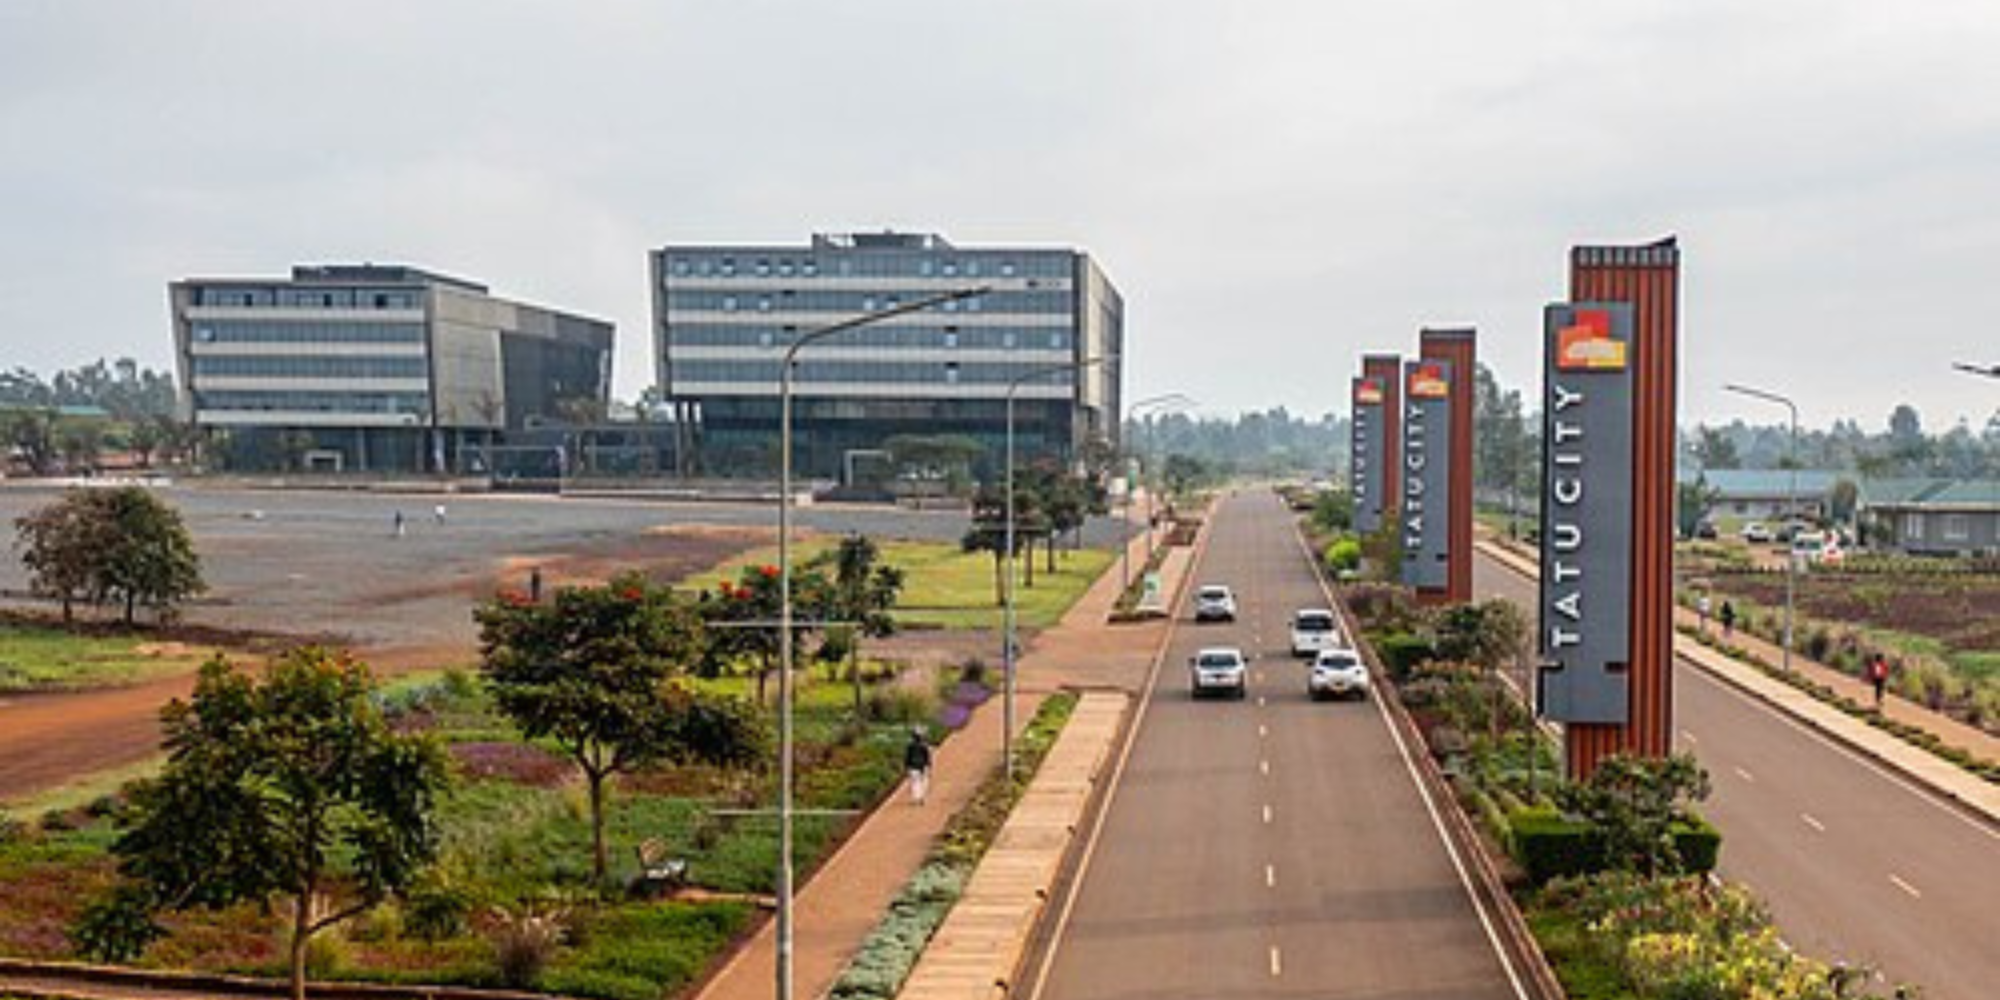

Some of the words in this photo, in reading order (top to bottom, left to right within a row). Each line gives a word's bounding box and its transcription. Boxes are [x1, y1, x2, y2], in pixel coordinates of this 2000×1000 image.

[1408, 405, 1424, 470] CITY
[1554, 384, 1584, 504] CITY
[1407, 478, 1424, 547] TATU
[1552, 524, 1583, 647] TATU
